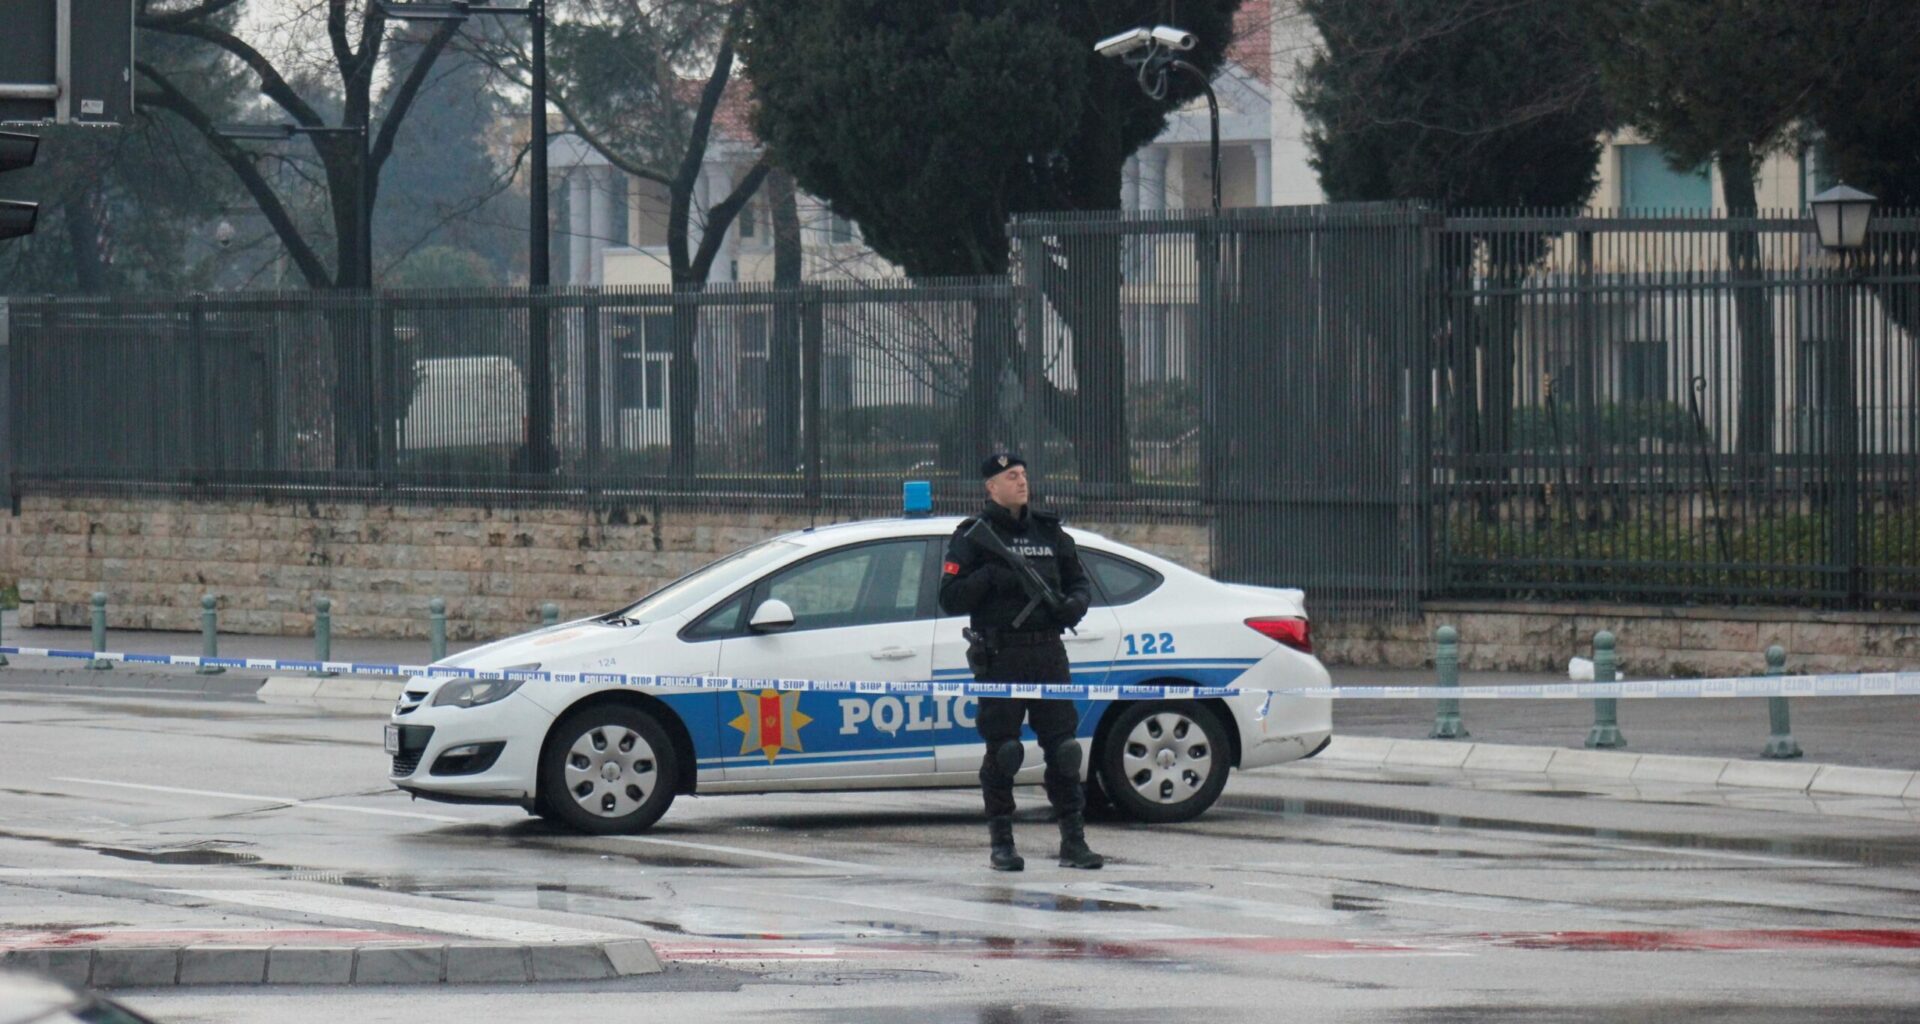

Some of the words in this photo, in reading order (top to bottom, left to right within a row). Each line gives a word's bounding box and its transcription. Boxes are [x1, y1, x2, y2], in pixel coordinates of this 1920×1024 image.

[1123, 632, 1175, 656] 122
[631, 676, 652, 686] STOP
[660, 677, 697, 686] POLICIJA
[707, 678, 728, 688] STOP
[736, 679, 774, 688] POLICIJA
[783, 680, 804, 689] STOP
[860, 682, 881, 690] STOP
[890, 682, 928, 691] POLICIJA
[938, 682, 959, 691] STOP
[968, 682, 1007, 692] POLICIJA
[1016, 684, 1038, 692] STOP
[1046, 685, 1084, 693] POLICIJA
[1123, 685, 1159, 693] POLICIJA
